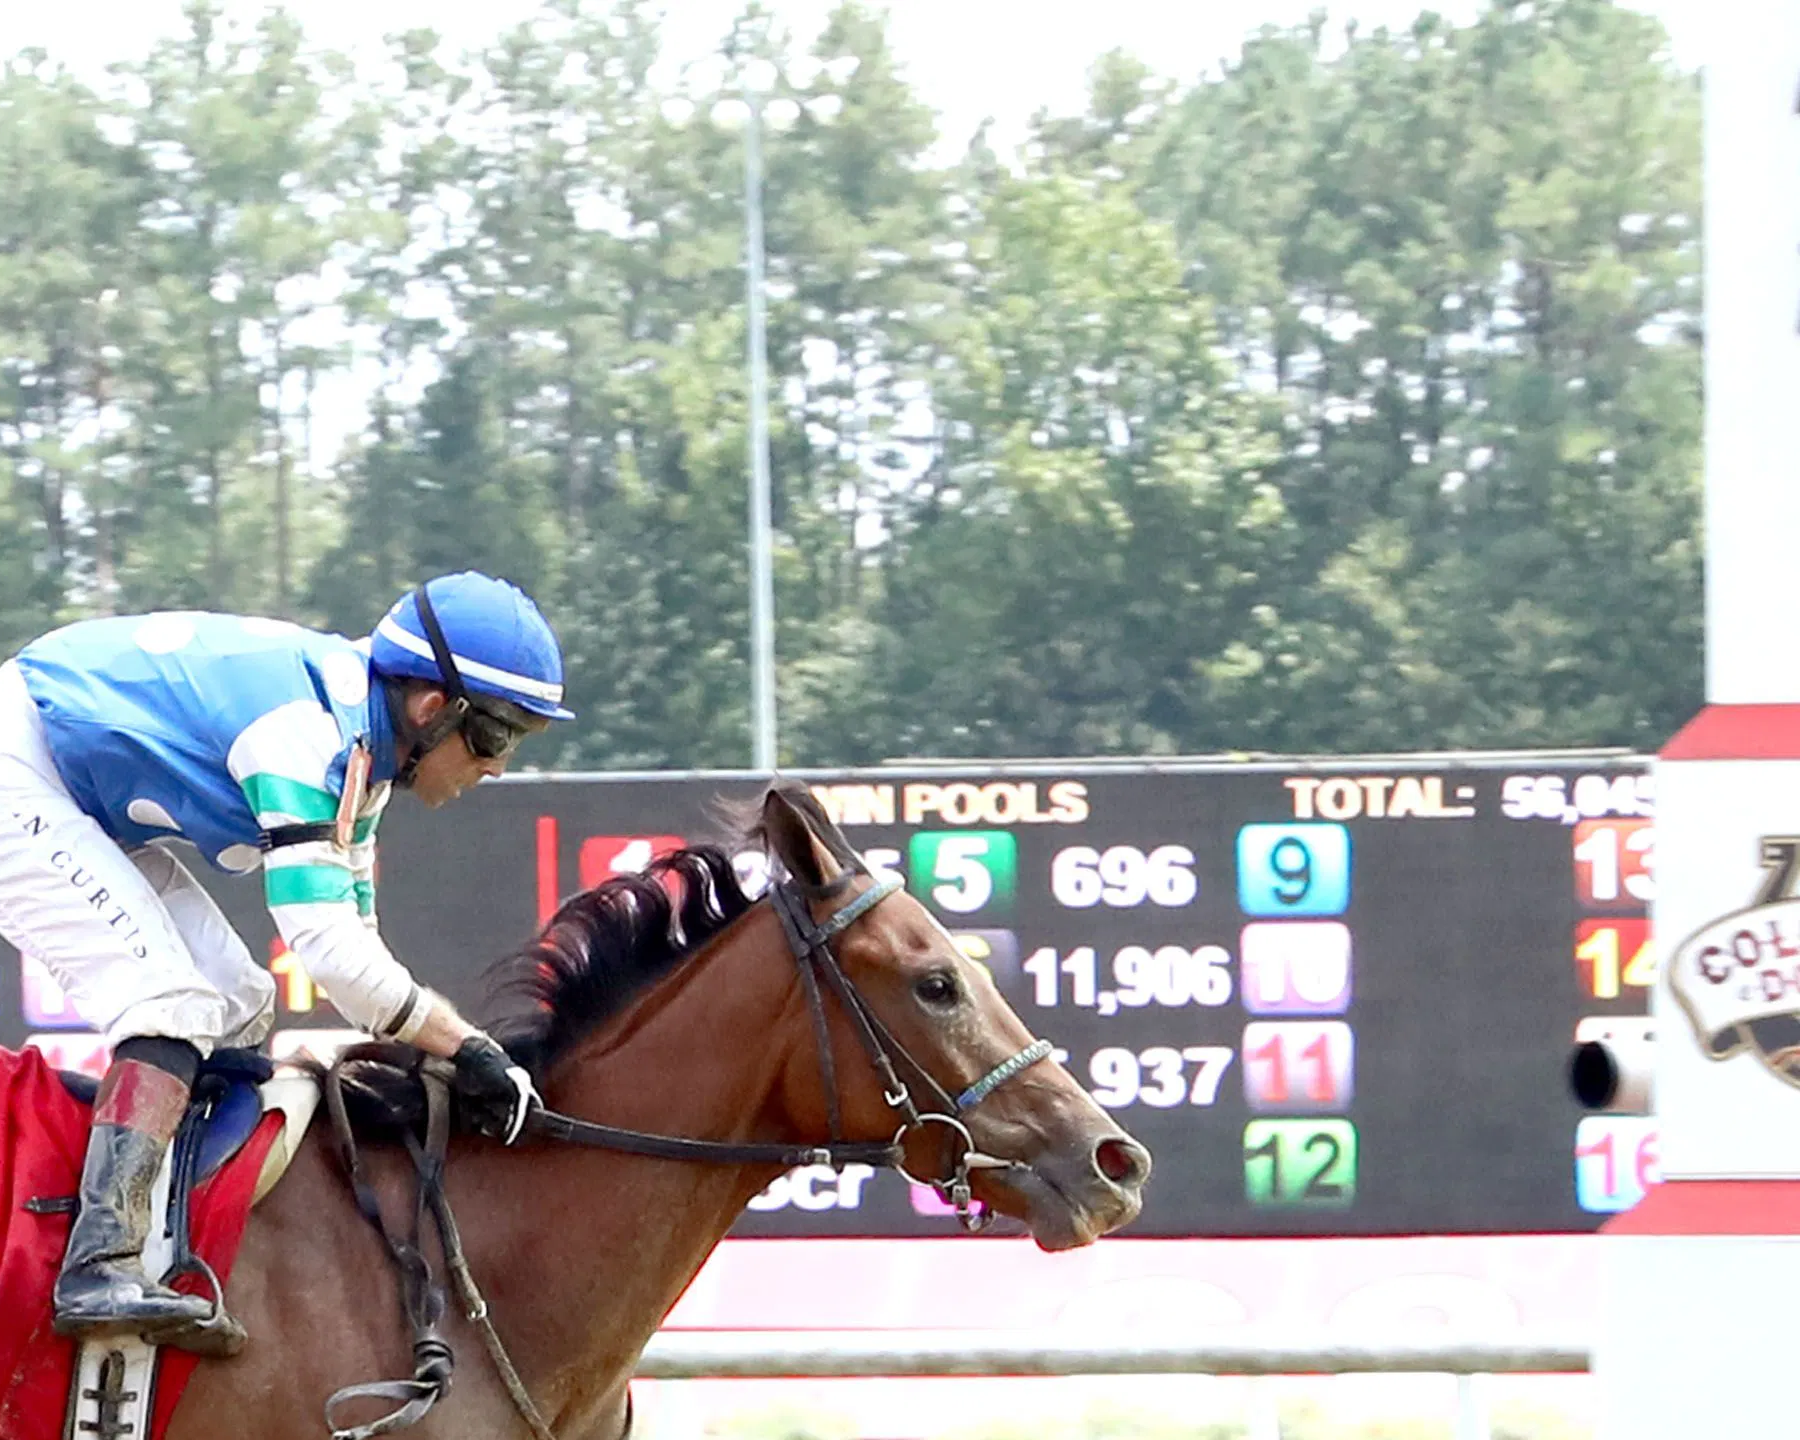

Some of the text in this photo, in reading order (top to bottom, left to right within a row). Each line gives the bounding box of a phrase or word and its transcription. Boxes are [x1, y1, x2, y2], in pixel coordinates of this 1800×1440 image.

[903, 781, 1090, 825] POOLS
[932, 836, 990, 913] 5
[1051, 845, 1198, 909] 696
[1270, 835, 1312, 906] 9
[1022, 944, 1233, 1016] 11,906
[1245, 1033, 1337, 1104] 11
[1243, 1132, 1344, 1199] 12
